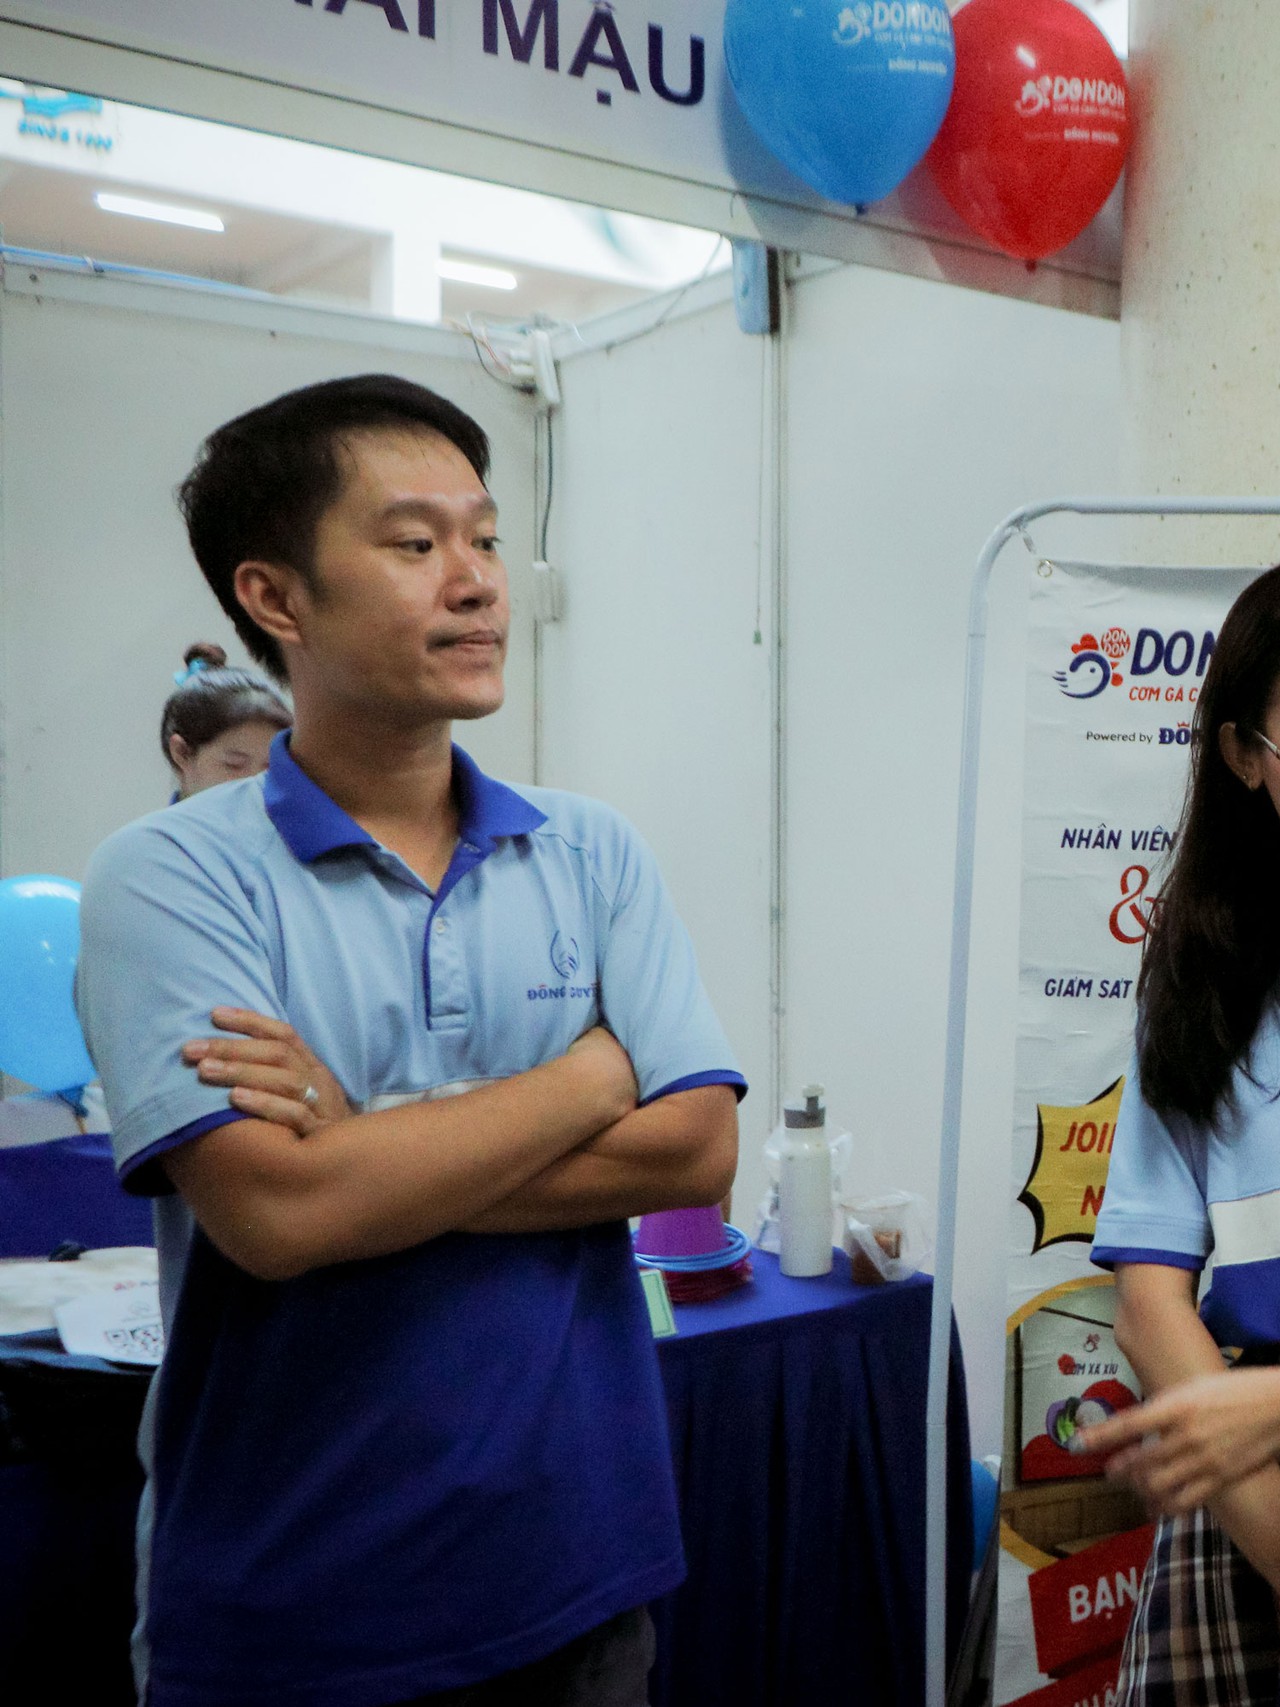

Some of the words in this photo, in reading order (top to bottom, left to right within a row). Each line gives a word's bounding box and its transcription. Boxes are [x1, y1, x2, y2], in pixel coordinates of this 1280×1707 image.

[873, 1, 951, 33] DONDON
[1053, 76, 1126, 109] DONDON
[1086, 731, 1136, 743] Powered
[1139, 732, 1153, 744] by
[1060, 823, 1122, 850] NHÂN
[1131, 824, 1181, 852] VIÊN
[1109, 865, 1167, 944] &
[1045, 976, 1093, 998] GIÁM
[1098, 978, 1133, 999] SÁT
[1068, 1567, 1140, 1624] BẠN
